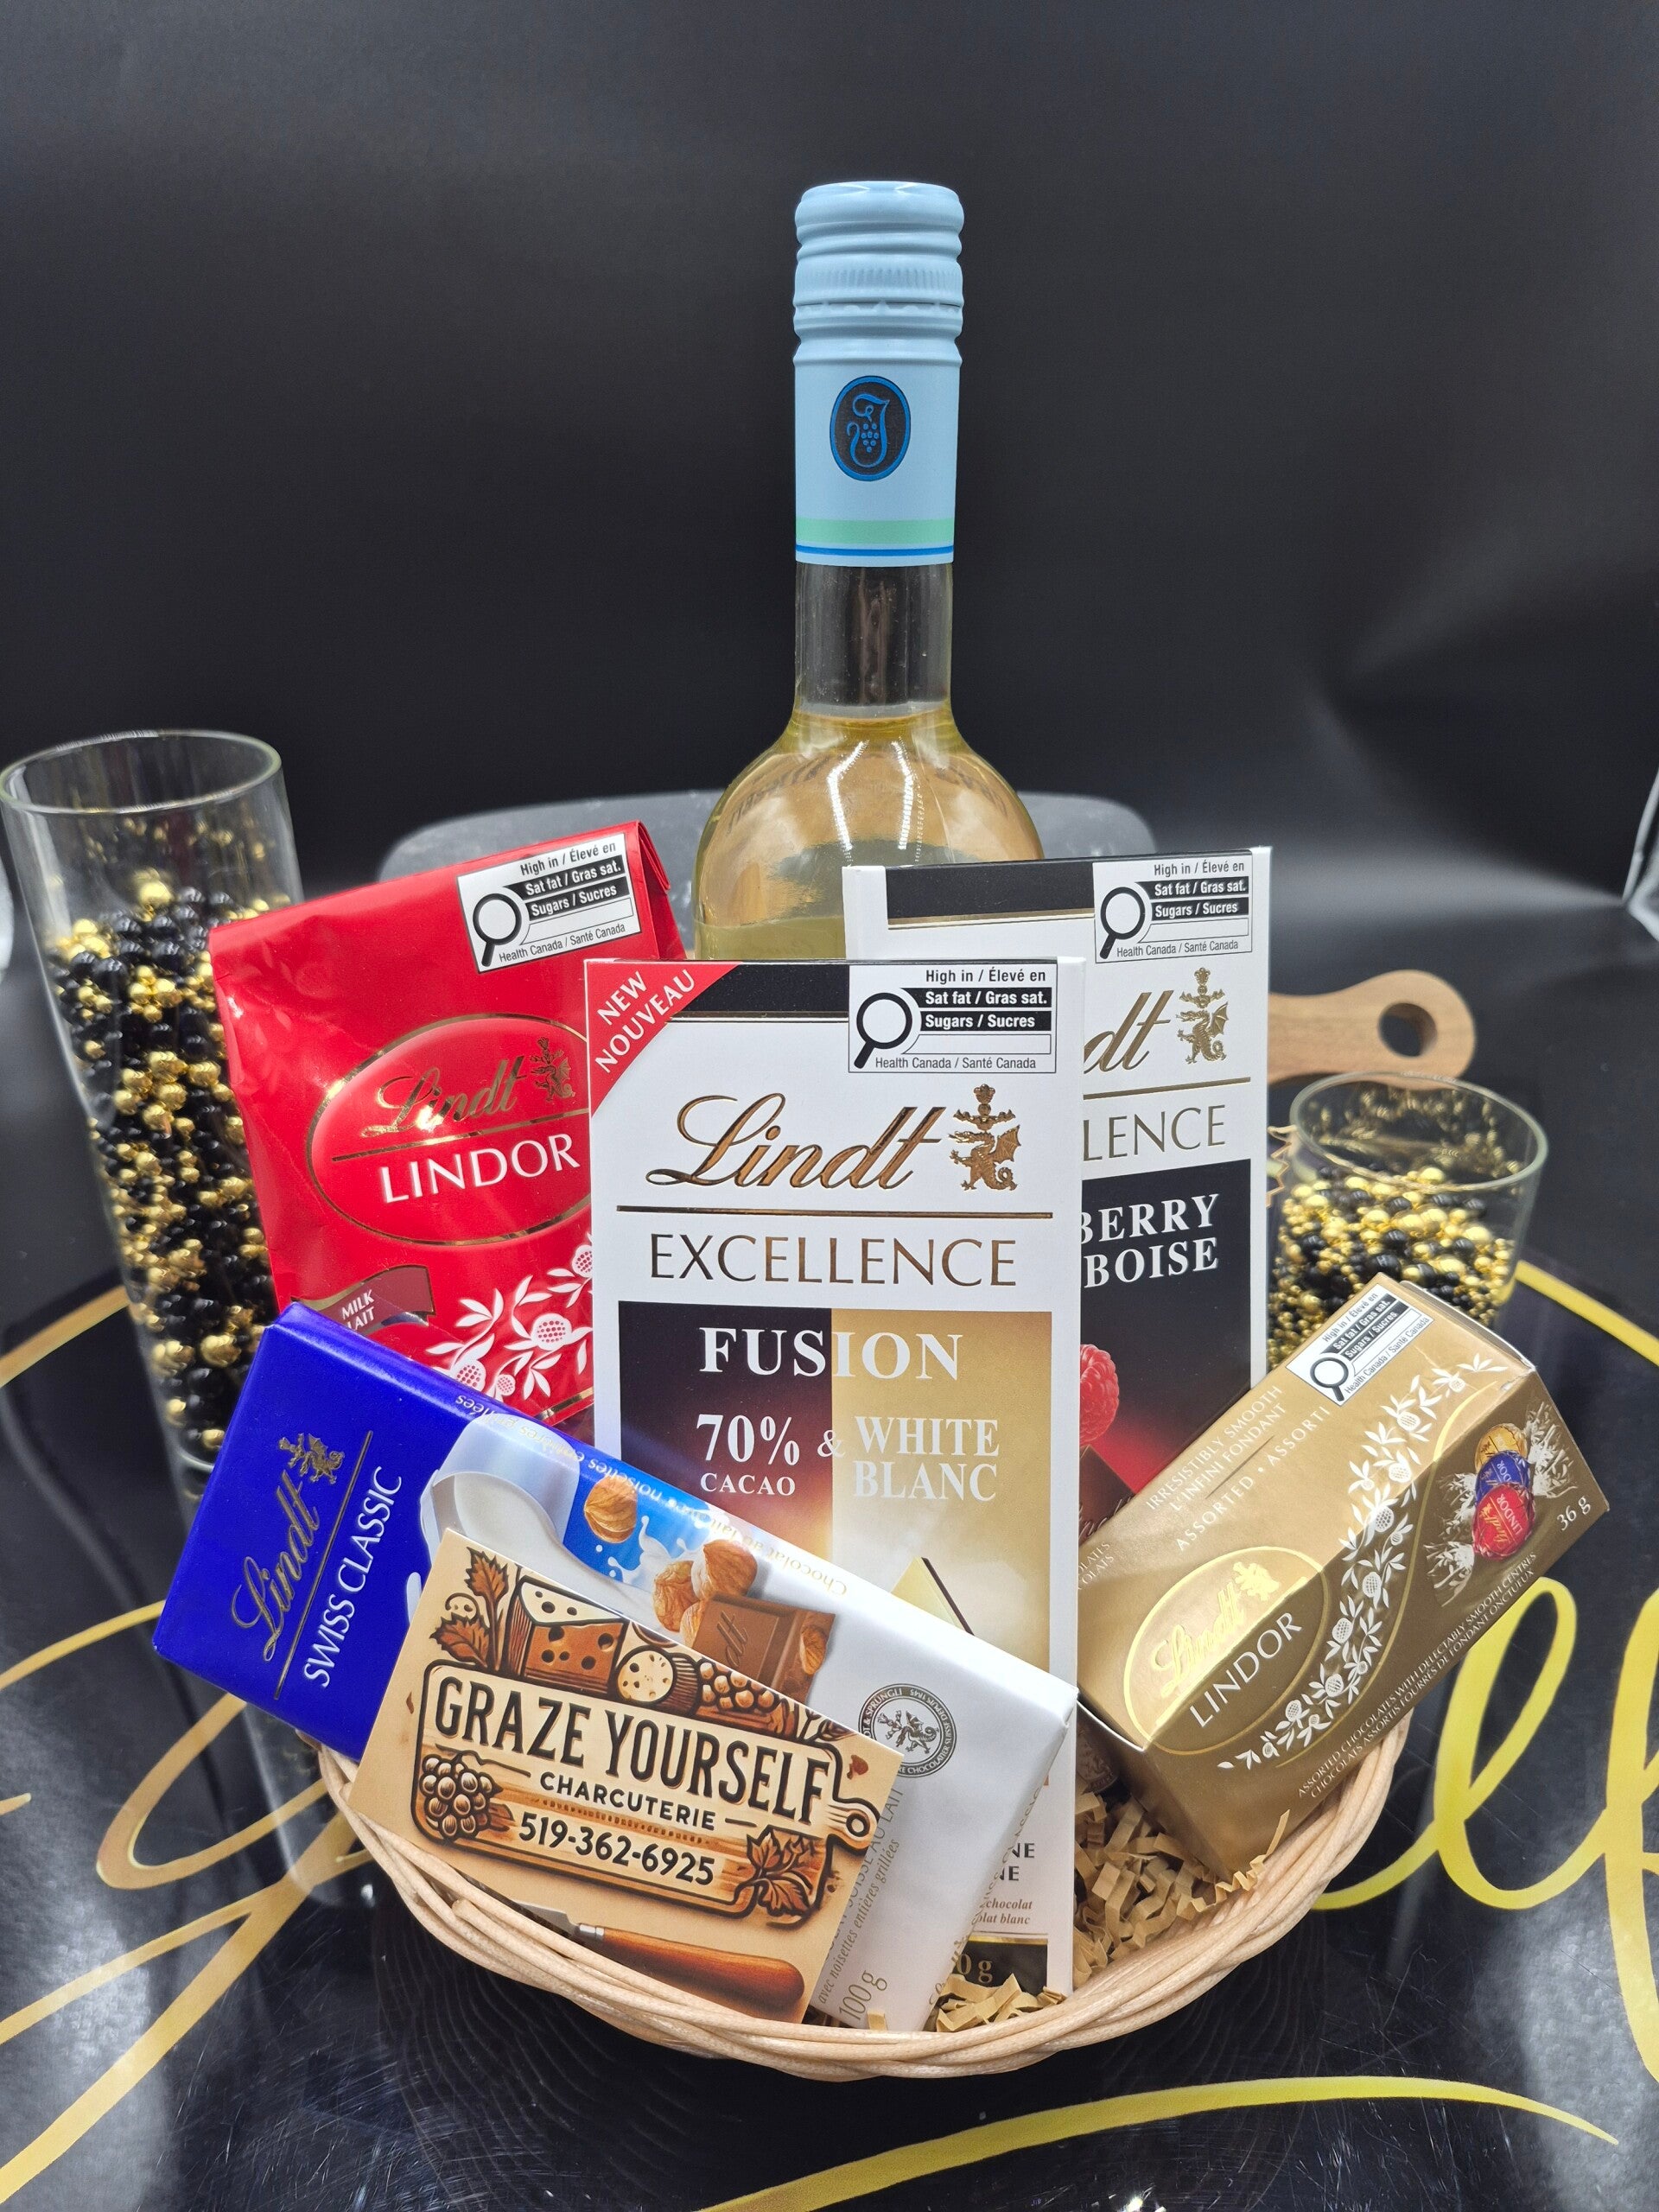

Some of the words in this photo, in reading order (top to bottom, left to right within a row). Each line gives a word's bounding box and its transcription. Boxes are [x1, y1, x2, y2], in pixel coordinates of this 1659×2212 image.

[520, 860, 546, 877] High
[548, 856, 558, 868] in
[562, 854, 566, 865] /
[569, 845, 599, 862] Élevé
[602, 842, 616, 854] en
[525, 881, 545, 896] Sat
[546, 876, 563, 891] fat
[563, 873, 569, 887] /
[571, 869, 598, 885] Gras
[600, 861, 621, 876] sat.
[1154, 864, 1178, 878] High
[1181, 863, 1191, 874] in
[1194, 862, 1199, 874] /
[1203, 859, 1229, 873] Élevé
[1232, 862, 1244, 872] en
[531, 897, 570, 917] Sugars
[571, 893, 576, 907] /
[579, 885, 617, 904] Sucres
[1154, 883, 1173, 897] Sat
[1175, 883, 1191, 895] fat
[1192, 881, 1198, 895] /
[1200, 881, 1224, 893] Gras
[1227, 880, 1246, 892] sat.
[1155, 905, 1192, 919] Sugars
[1194, 902, 1200, 915] /
[1203, 902, 1238, 915] Sucres
[499, 945, 529, 963] Health
[531, 938, 563, 956] Canada
[570, 931, 594, 946] Santé
[595, 923, 626, 940] Canada
[1116, 945, 1144, 957] Health
[1146, 944, 1177, 956] Canada
[1185, 940, 1207, 952] Santé
[1210, 940, 1238, 951] Canada
[596, 969, 648, 1027] NEW
[925, 969, 956, 985] High
[961, 969, 973, 982] in
[978, 969, 984, 982] /
[988, 966, 1025, 982] Élevé
[1030, 971, 1046, 982] en
[925, 991, 949, 1004] Sat
[951, 991, 973, 1004] fat
[975, 991, 982, 1005] /
[985, 991, 1018, 1004] Gras
[1020, 991, 1047, 1004] sat.
[594, 969, 696, 1073] NOUVEAU
[925, 1014, 974, 1030] Sugars
[976, 1014, 983, 1028] /
[987, 1014, 1035, 1028] Sucres
[1084, 989, 1174, 1074] dt
[875, 1057, 909, 1069] Health
[912, 1057, 952, 1069] Canada
[954, 1058, 959, 1070] /
[962, 1056, 993, 1069] Santé
[995, 1057, 1037, 1069] Canada
[361, 1056, 530, 1139] Lindt
[645, 1092, 947, 1190] Lindt
[1084, 1104, 1225, 1161] LENCE
[380, 1132, 581, 1205] LINDOR
[1080, 1193, 1220, 1244] BERRY
[652, 1234, 1016, 1287] EXCELLENCE
[1084, 1237, 1219, 1288] BOISE
[341, 1289, 375, 1320] MILK
[1322, 1329, 1340, 1343] High
[1339, 1321, 1348, 1330] in
[1349, 1300, 1370, 1319] Élevé
[1369, 1293, 1378, 1301] en
[1332, 1339, 1348, 1350] Sat
[1345, 1329, 1357, 1341] fat
[1360, 1310, 1377, 1326] Gras
[1376, 1300, 1391, 1313] sat.
[699, 1327, 964, 1381] FUSION
[1344, 1335, 1370, 1358] Sugars
[1372, 1311, 1398, 1333] Sucres
[1344, 1376, 1366, 1394] Health
[1363, 1355, 1388, 1376] Canada
[1388, 1337, 1408, 1353] Santé
[1405, 1317, 1429, 1338] Canada
[696, 1414, 800, 1465] 70%
[817, 1428, 845, 1459] &
[854, 1414, 1000, 1459] WHITE
[1146, 1436, 1224, 1510] IRRESISTIBLY
[1224, 1385, 1282, 1440] SMOOTH
[1170, 1460, 1225, 1512] L'INFINI
[1223, 1404, 1286, 1463] FONDANT
[588, 1459, 663, 1500] noisettes
[700, 1472, 796, 1497] CACAO
[854, 1459, 999, 1502] BLANC
[1175, 1476, 1255, 1552] ASSORTED
[1265, 1406, 1331, 1467] ASSORTI
[1497, 1493, 1523, 1535] LINDOR
[1557, 1505, 1578, 1531] 36
[1578, 1495, 1592, 1516] g
[232, 1469, 320, 1662] Lindt
[304, 1593, 356, 1688] SWISS
[337, 1465, 403, 1593] CLASSIC
[767, 1547, 848, 1597] Chocolat
[1150, 1581, 1244, 1699] Lindt
[1189, 1612, 1302, 1728] LINDOR
[1299, 1751, 1341, 1797] ASSORTED
[1341, 1692, 1397, 1754] CHOCOLATES
[1395, 1669, 1422, 1699] WITH
[1417, 1622, 1467, 1673] DELECTABLY
[1465, 1585, 1503, 1624] SMOOTH
[1502, 1553, 1536, 1588] CENTRES
[1310, 1742, 1363, 1799] CHOCOLATS
[1363, 1700, 1407, 1745] ASSORTIS
[1436, 1655, 1452, 1669] DE
[1448, 1615, 1491, 1658] FONDANT
[1489, 1569, 1535, 1617] ONCTUEUX
[435, 1675, 591, 1771] GRAZE
[604, 1709, 832, 1825] YOURSELF
[907, 1745, 950, 1774] CHOCOLATIER
[540, 1771, 717, 1832] CHARCUTERIE
[518, 1813, 715, 1887] 519-362-6925
[1012, 1842, 1035, 1859] NE
[817, 1985, 836, 2005] avec
[830, 1929, 858, 1984] noisettes
[854, 1883, 880, 1930] entières
[874, 1838, 900, 1884] grillées
[986, 1898, 1033, 1910] chocolat
[999, 1913, 1031, 1925] blanc
[838, 1982, 873, 2022] 100
[861, 1970, 888, 1992] g
[978, 1960, 994, 1984] g
